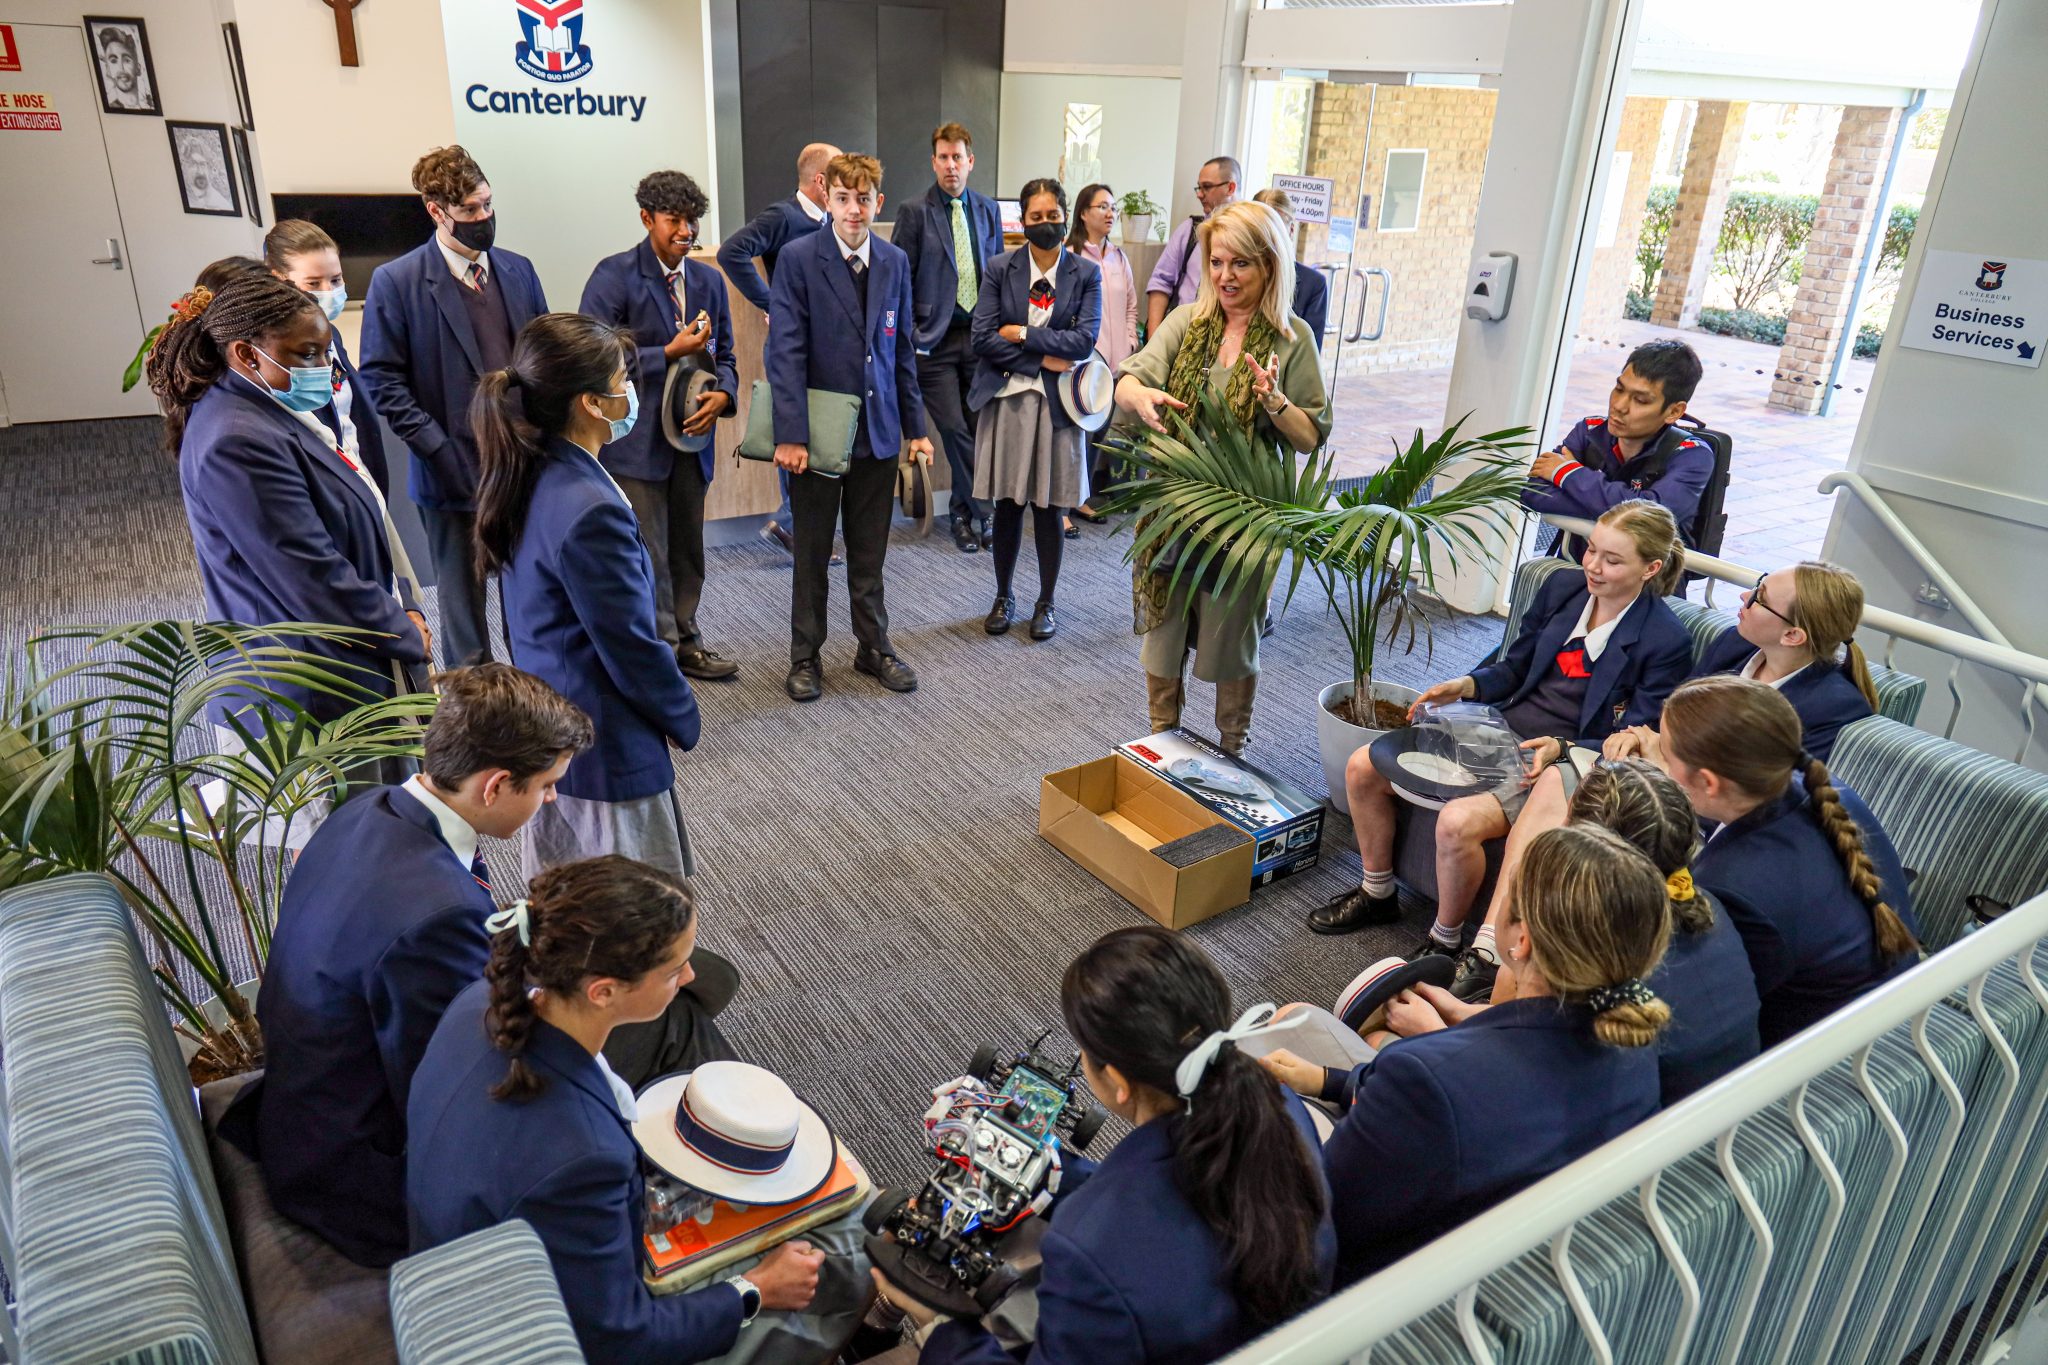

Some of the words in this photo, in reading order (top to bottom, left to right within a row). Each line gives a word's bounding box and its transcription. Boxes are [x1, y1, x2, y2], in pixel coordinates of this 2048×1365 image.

[13, 94, 47, 108] HOSE
[466, 84, 647, 122] Canterbury
[1, 113, 60, 129] EXTINGUISHER
[1279, 180, 1301, 189] OFFICE
[1302, 182, 1325, 192] HOURS
[1304, 195, 1323, 207] Friday
[1300, 208, 1325, 218] 4.00pm
[1958, 290, 2012, 302] CANTERBURY
[1935, 303, 2025, 329] Business
[1932, 324, 2015, 350] Services
